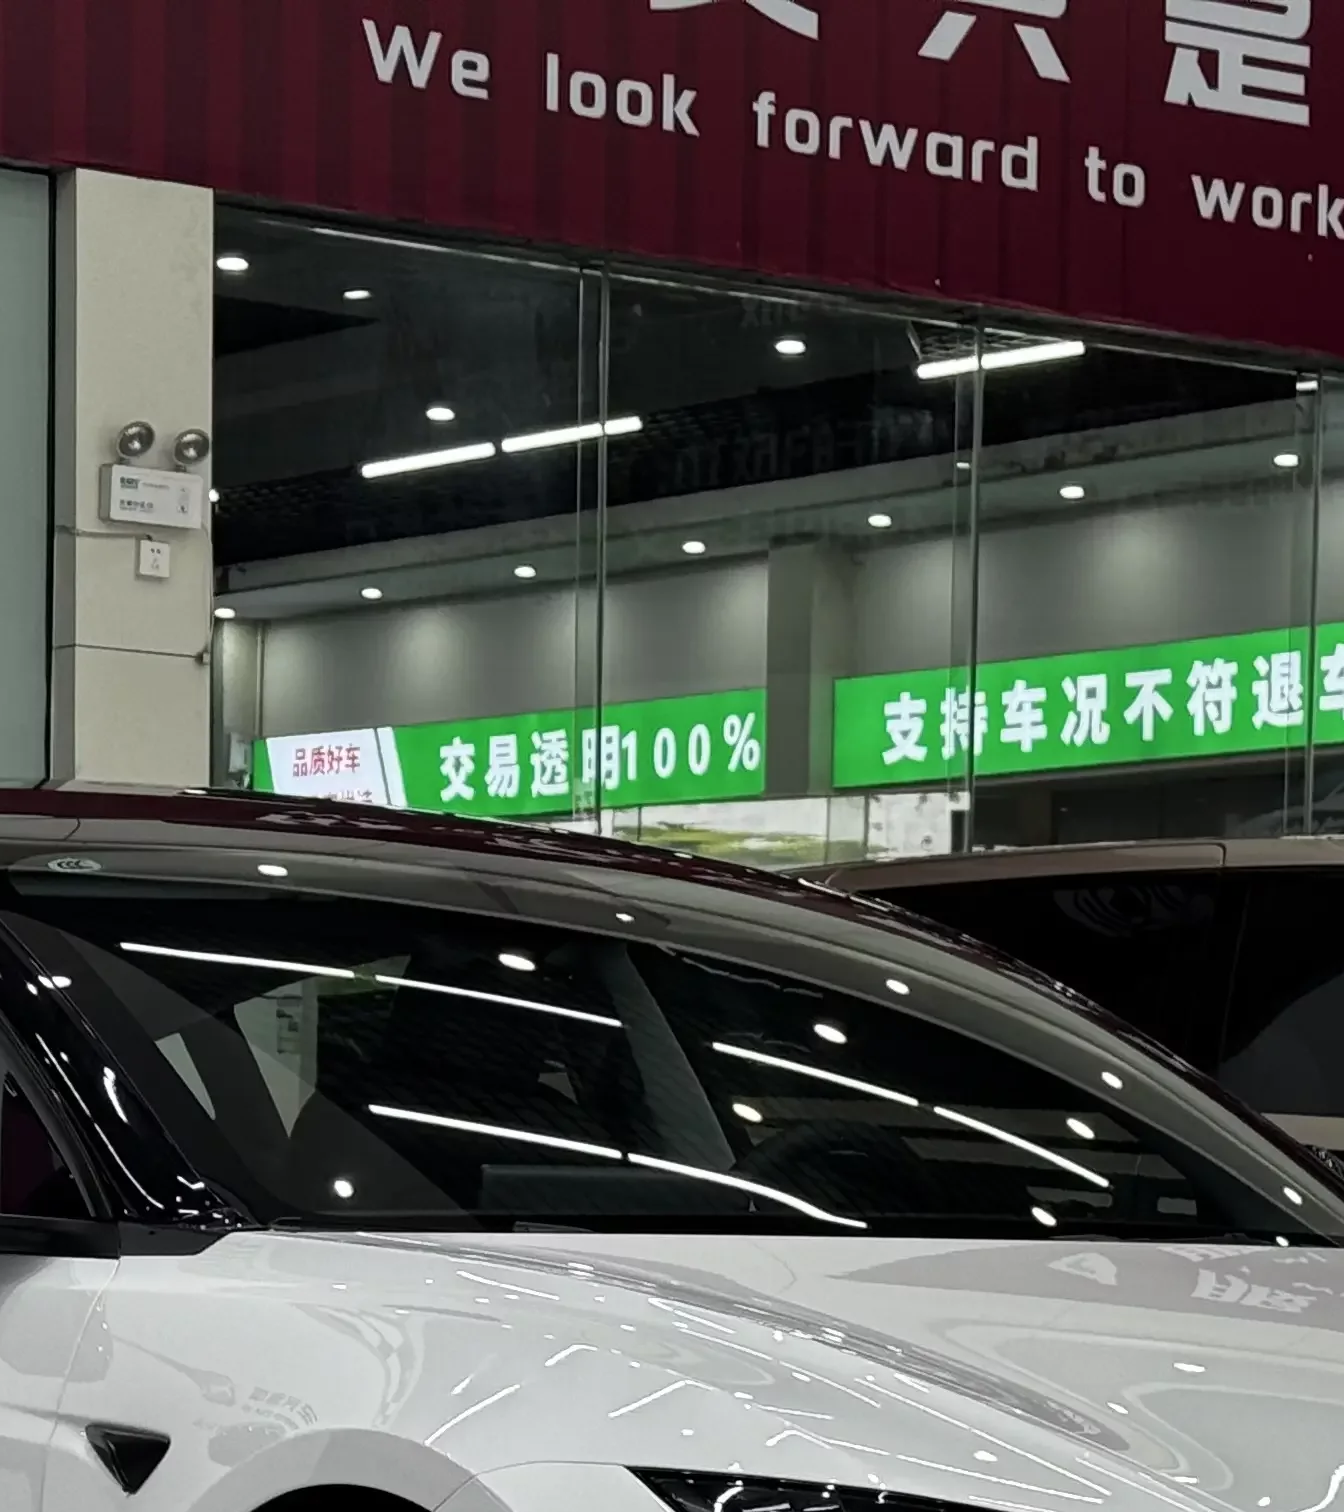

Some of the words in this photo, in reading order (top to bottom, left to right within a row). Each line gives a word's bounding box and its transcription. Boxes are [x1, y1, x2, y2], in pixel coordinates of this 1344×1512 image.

[360, 18, 490, 100] We
[545, 52, 700, 137] look
[751, 91, 1039, 191] forward
[1083, 146, 1146, 207] to
[292, 743, 361, 777] 品质好车
